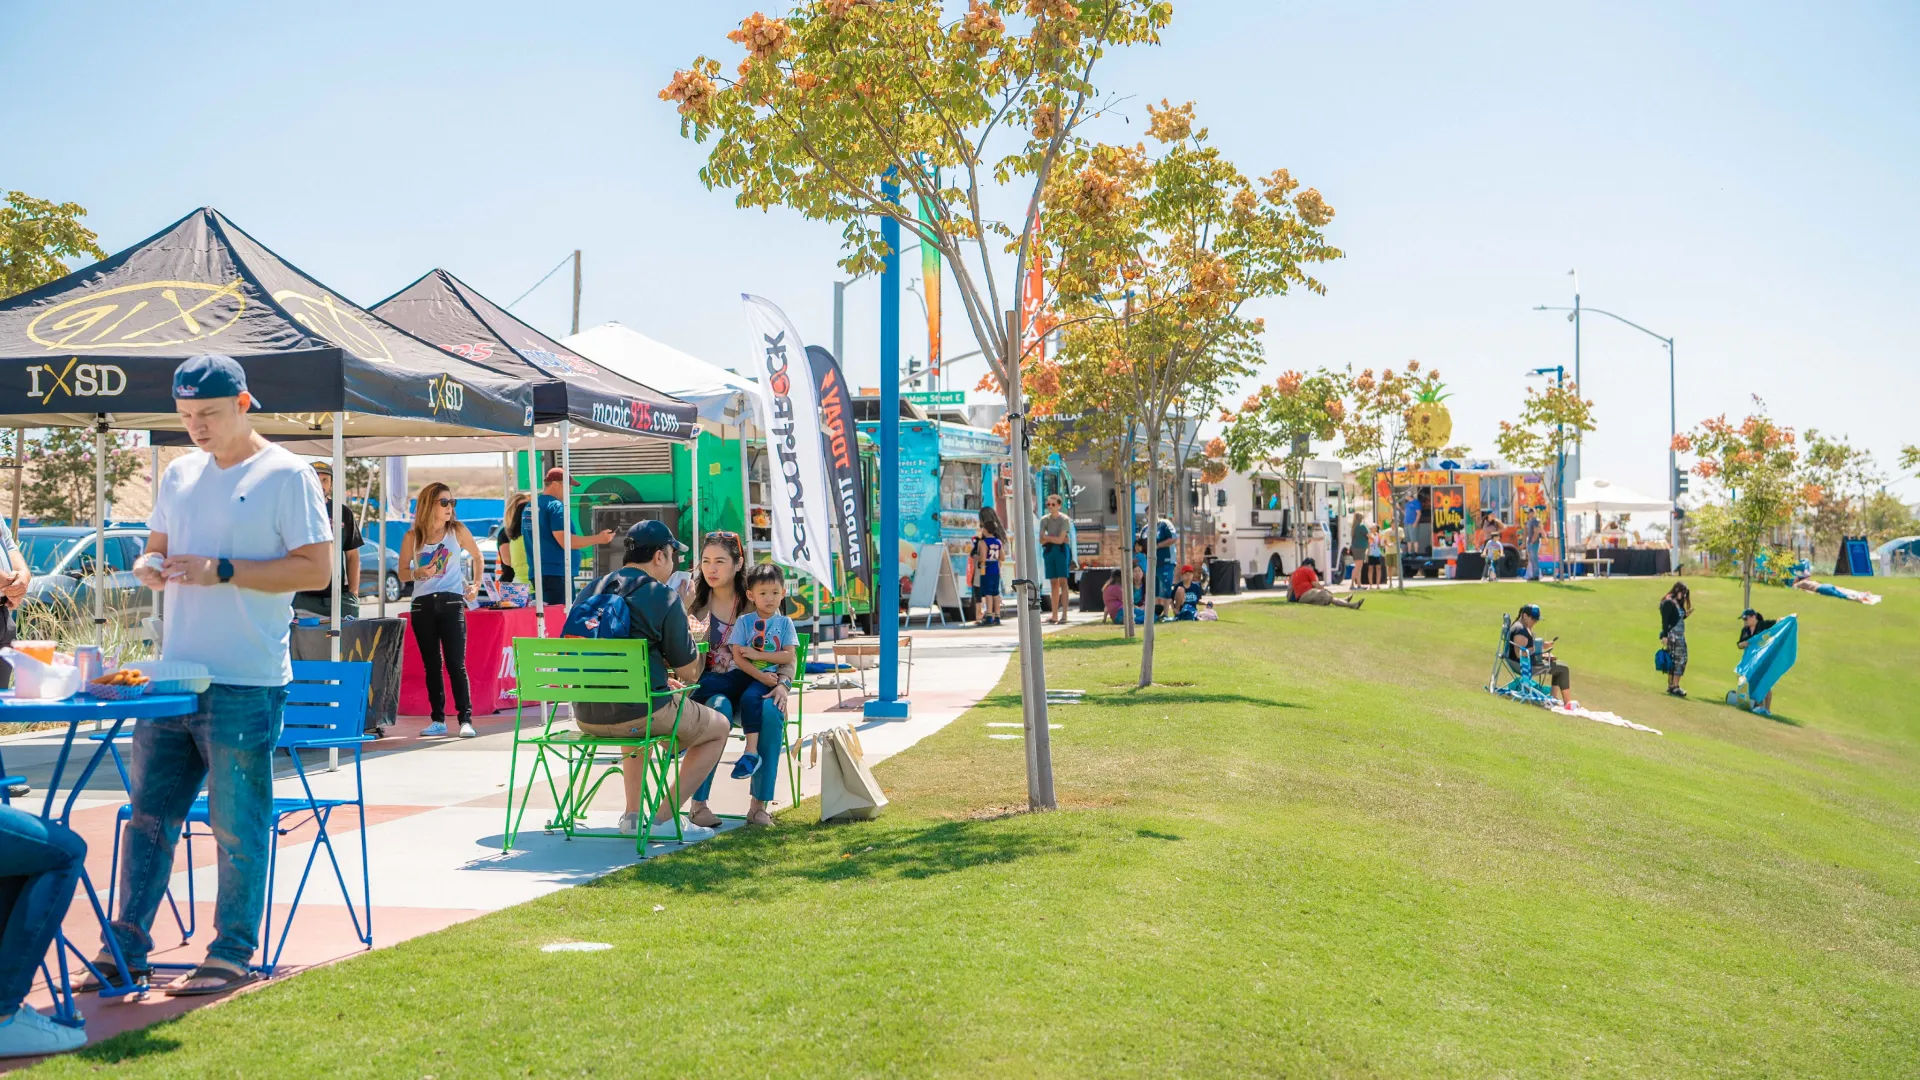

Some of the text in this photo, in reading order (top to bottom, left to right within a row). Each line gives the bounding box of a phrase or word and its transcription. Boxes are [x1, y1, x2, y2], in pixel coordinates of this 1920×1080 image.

[26, 356, 127, 405] IXSD
[427, 372, 464, 416] IXSD
[909, 392, 962, 403] Main Street E
[592, 399, 680, 433] magic925.com
[1433, 489, 1462, 509] Dole
[1434, 508, 1462, 529] Whip
